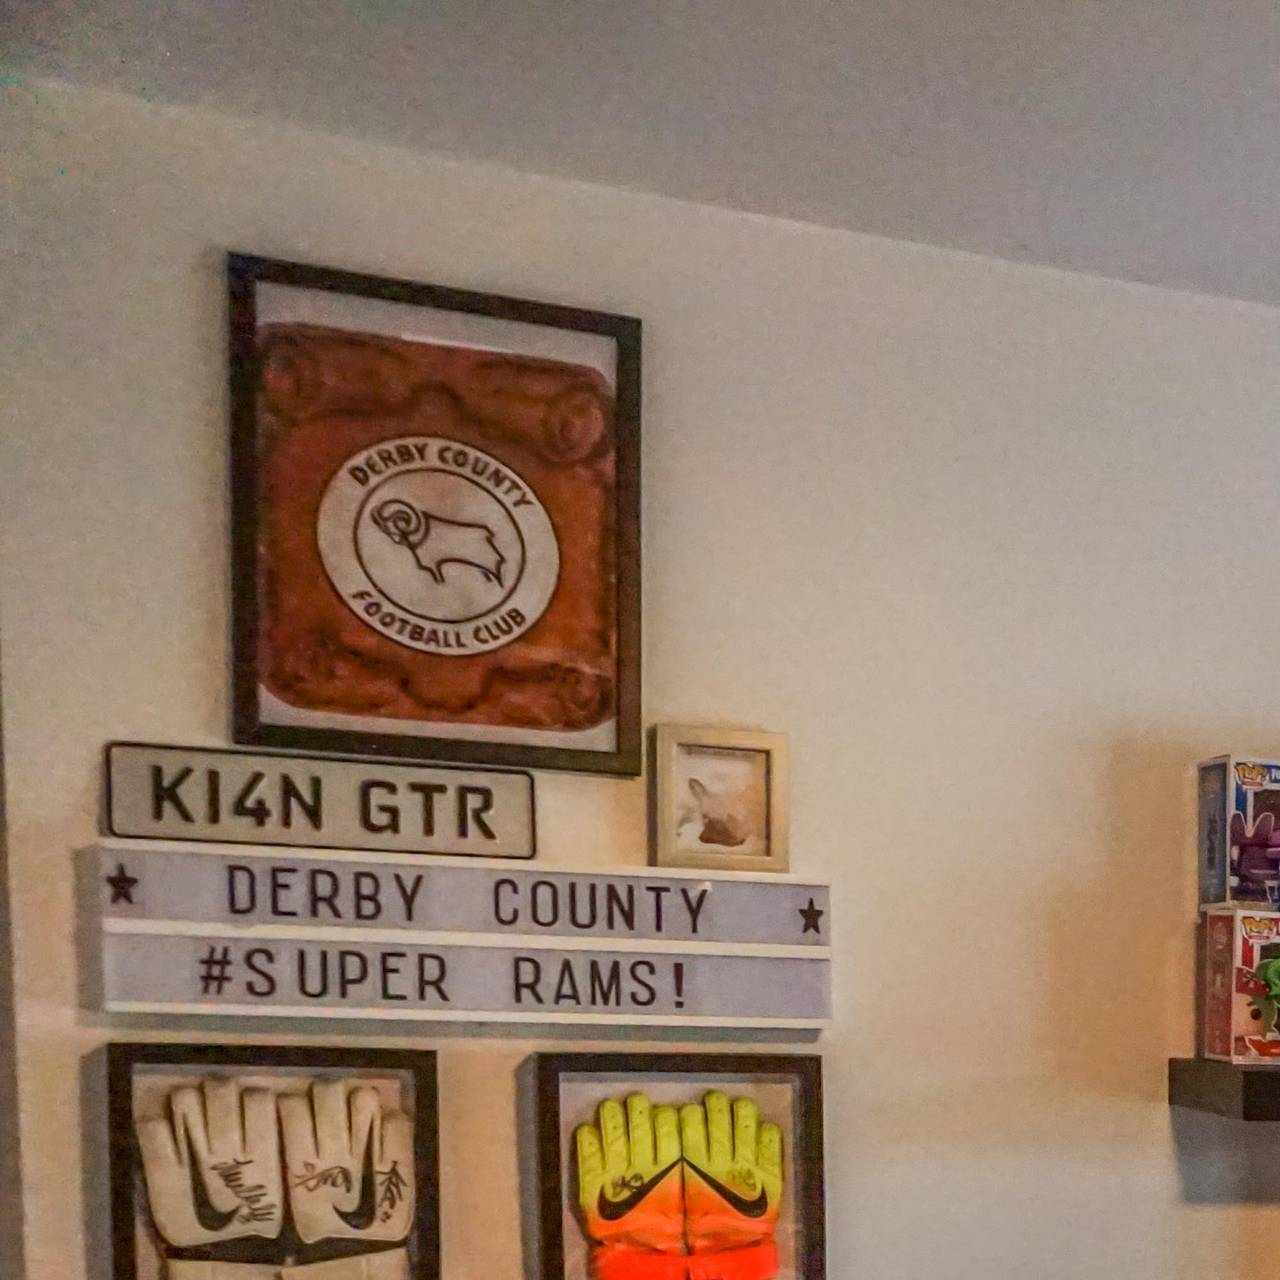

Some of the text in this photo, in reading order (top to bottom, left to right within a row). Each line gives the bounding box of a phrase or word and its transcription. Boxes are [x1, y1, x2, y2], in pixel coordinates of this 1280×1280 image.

[348, 442, 536, 508] DERBY COUNTY
[351, 589, 527, 649] FOOTBALL CLUB
[359, 780, 498, 841] GTR
[227, 863, 710, 934] DERBY COUNTY
[199, 945, 685, 1009] #SUPER RAMS!
